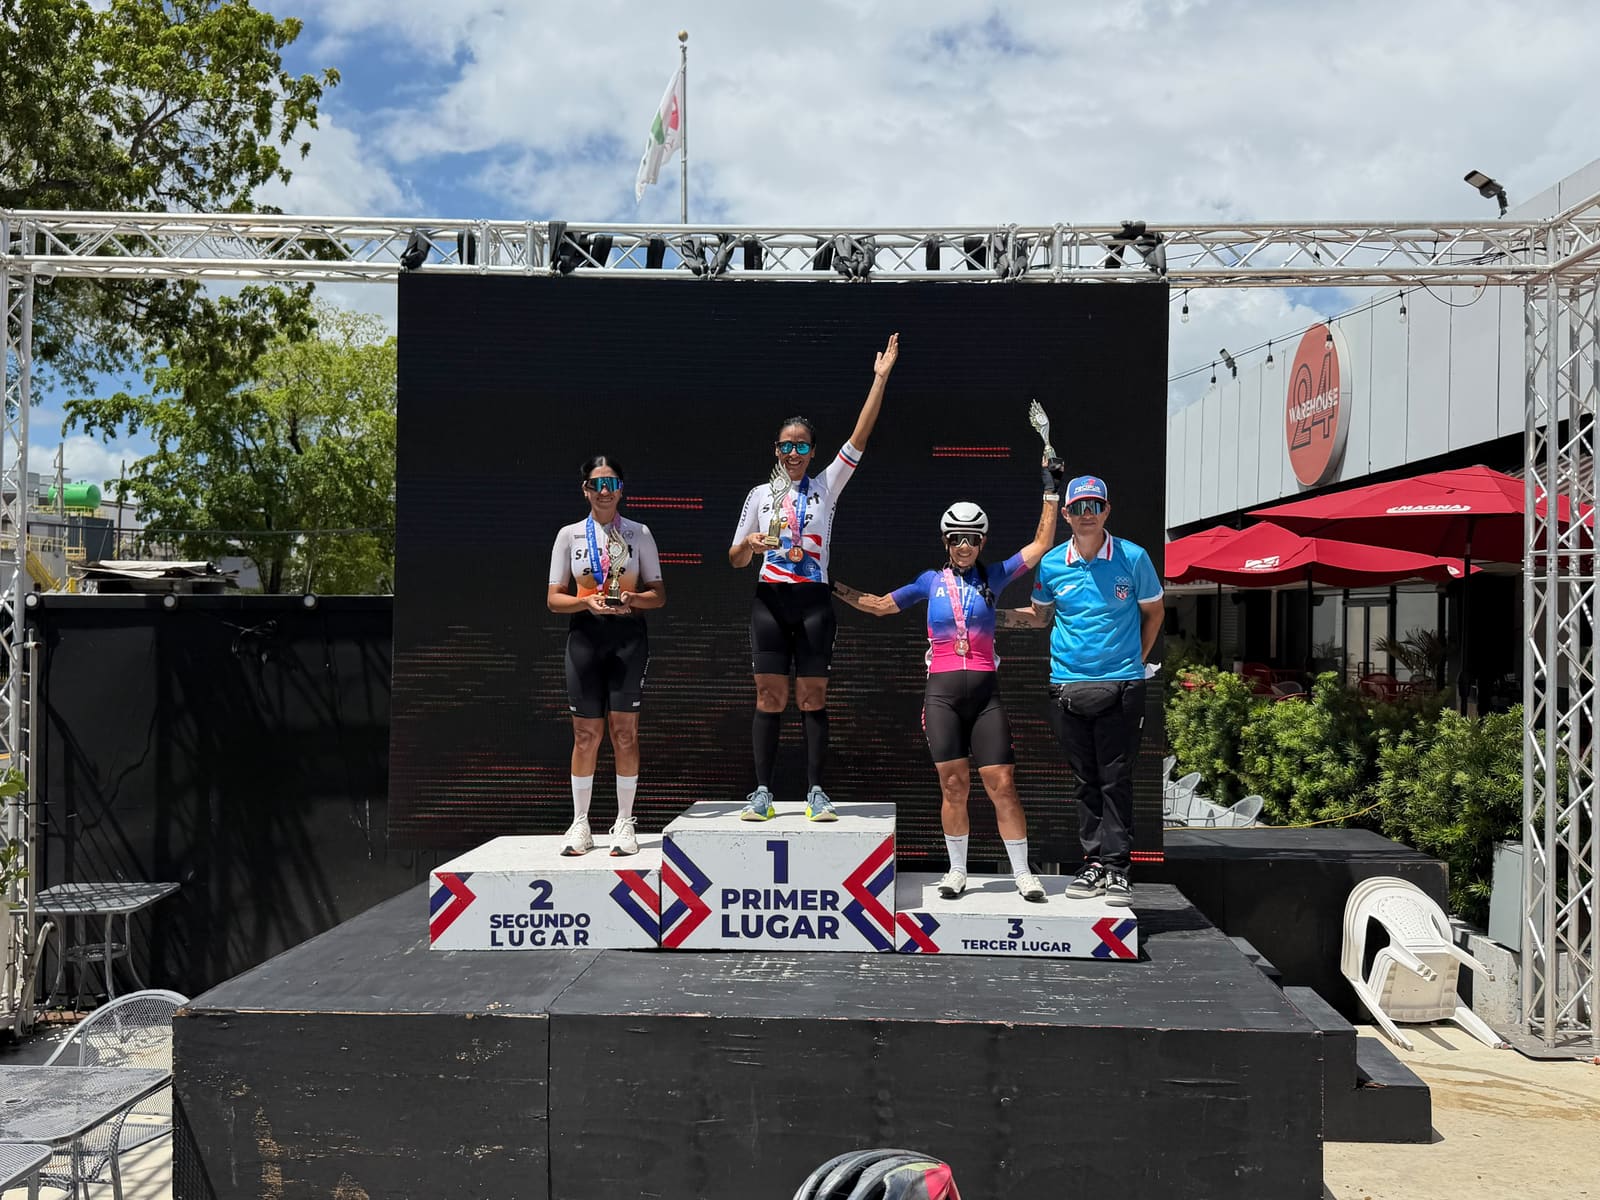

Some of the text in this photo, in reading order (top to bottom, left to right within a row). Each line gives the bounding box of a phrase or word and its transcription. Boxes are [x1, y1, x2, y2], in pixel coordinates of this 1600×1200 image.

[1288, 387, 1338, 424] WAREHOUSE
[766, 839, 789, 885] 1
[528, 879, 554, 910] 2
[721, 888, 840, 912] PRIMER
[489, 912, 591, 929] SEGUNDO
[721, 913, 840, 940] LUGAR
[1006, 917, 1025, 939] 3
[490, 929, 590, 947] LUGAR
[961, 939, 1072, 953] TERCER LUGAR
